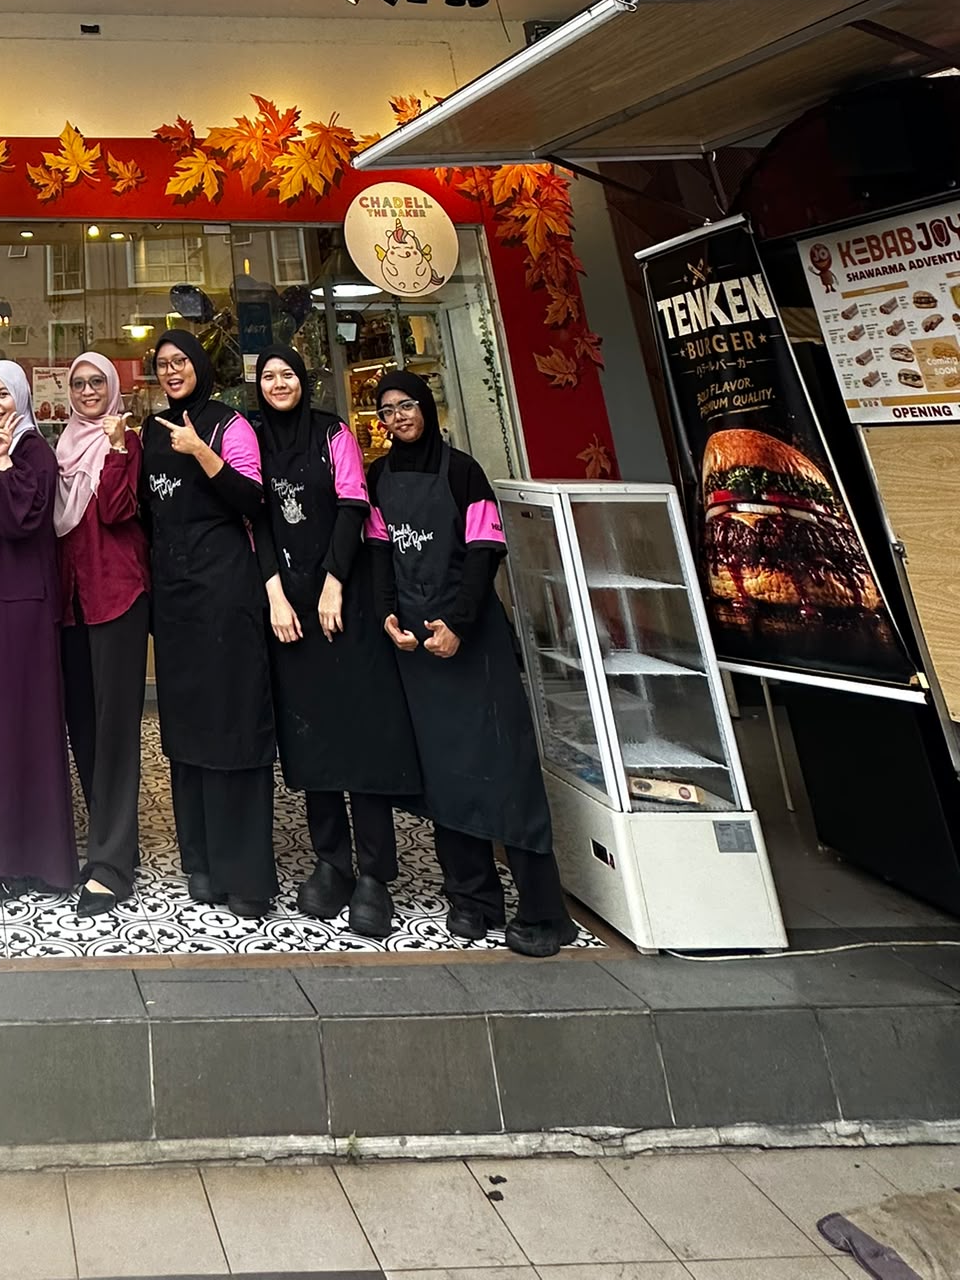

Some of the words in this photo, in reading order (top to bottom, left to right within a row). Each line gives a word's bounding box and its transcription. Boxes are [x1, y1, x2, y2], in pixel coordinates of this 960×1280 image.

[359, 196, 433, 209] CHADELL
[366, 209, 388, 217] THE
[390, 209, 427, 218] BAKER
[846, 262, 907, 282] SHAWARMA
[656, 273, 777, 339] TENKEN
[686, 330, 757, 360] BURGER
[710, 377, 754, 397] FLAVOR.
[732, 388, 776, 407] QUALITY.
[892, 405, 953, 419] OPENING
